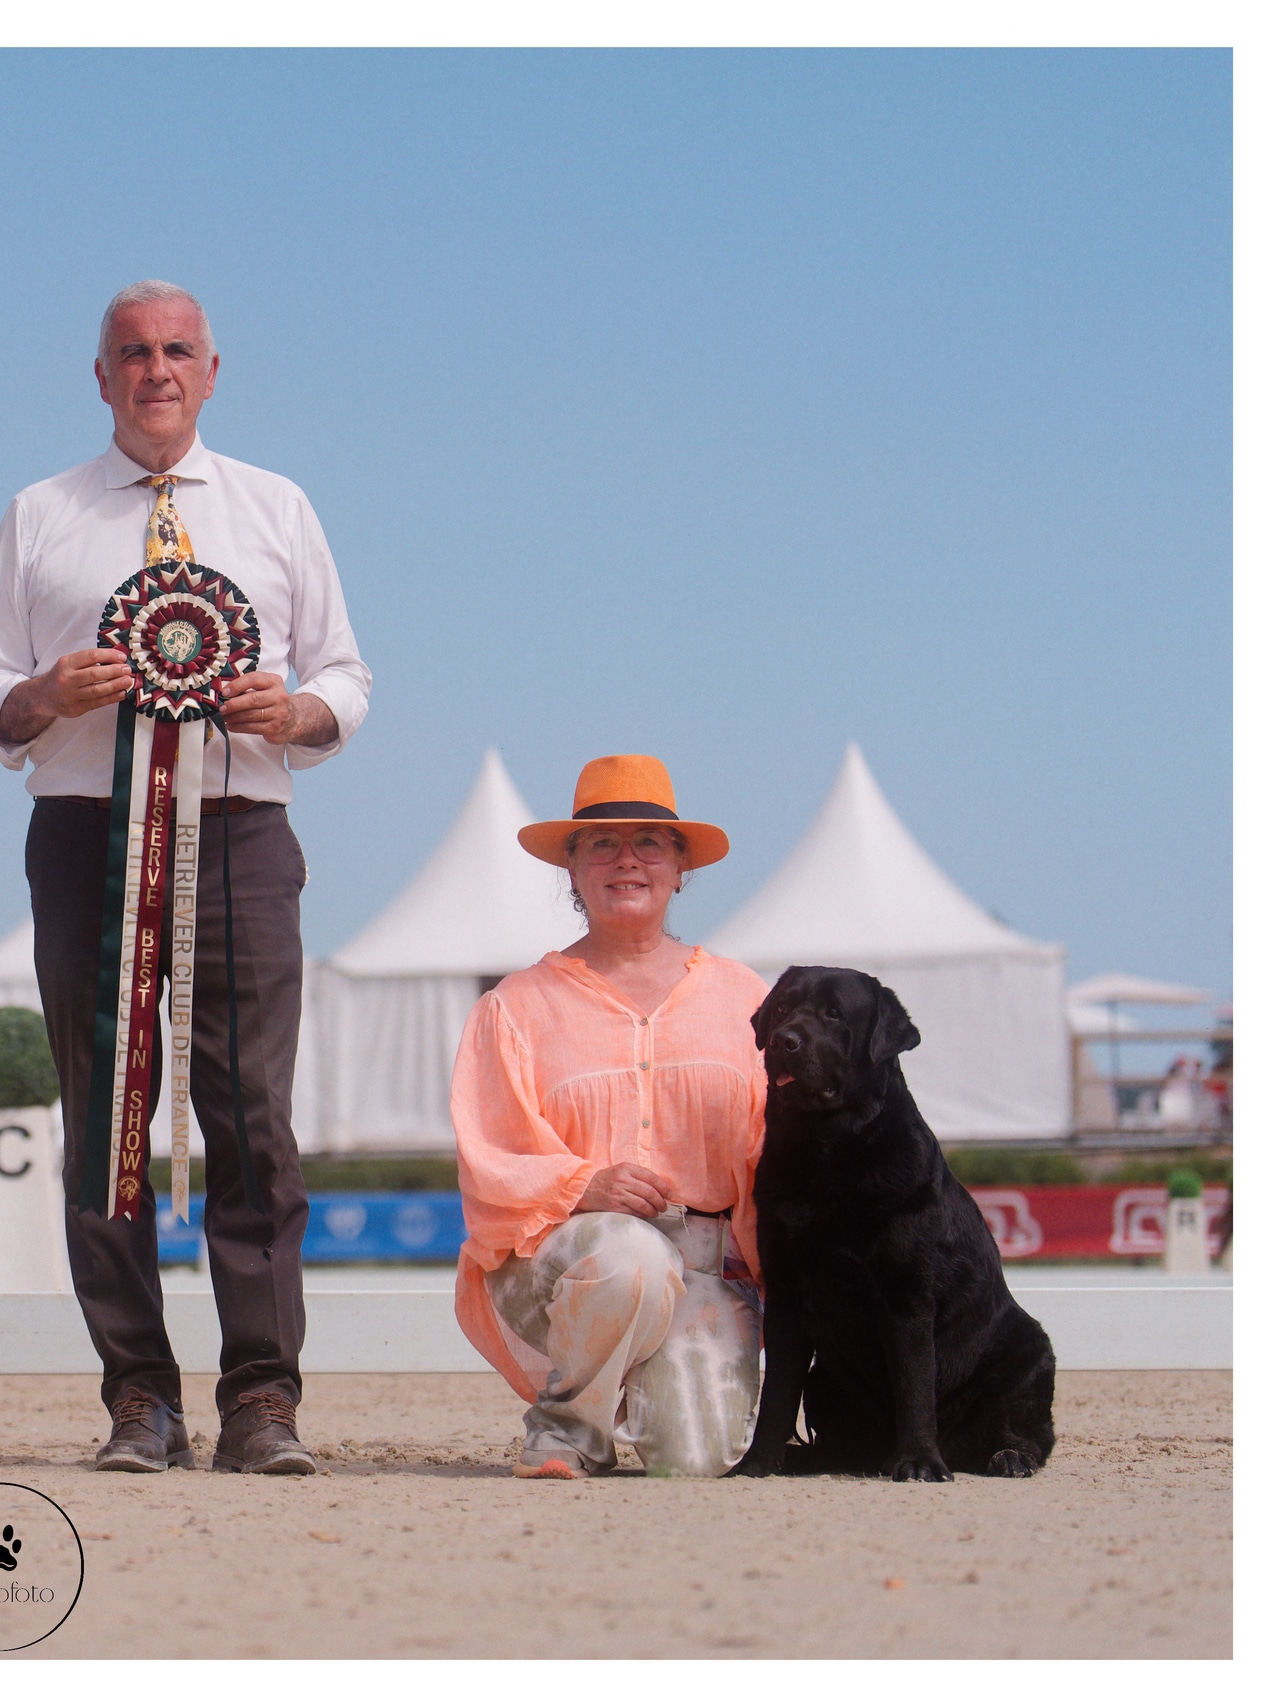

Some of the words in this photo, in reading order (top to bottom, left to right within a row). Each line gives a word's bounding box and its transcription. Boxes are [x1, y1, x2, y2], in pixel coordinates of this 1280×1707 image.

[146, 766, 168, 907] RESERVE
[173, 824, 198, 954] RETRIEVER
[137, 927, 155, 1008] BEST
[172, 962, 193, 1027] CLUB
[132, 1029, 147, 1069] IN
[171, 1035, 190, 1068] DE
[122, 1089, 143, 1171] SHOW
[171, 1075, 190, 1173] FRANCE
